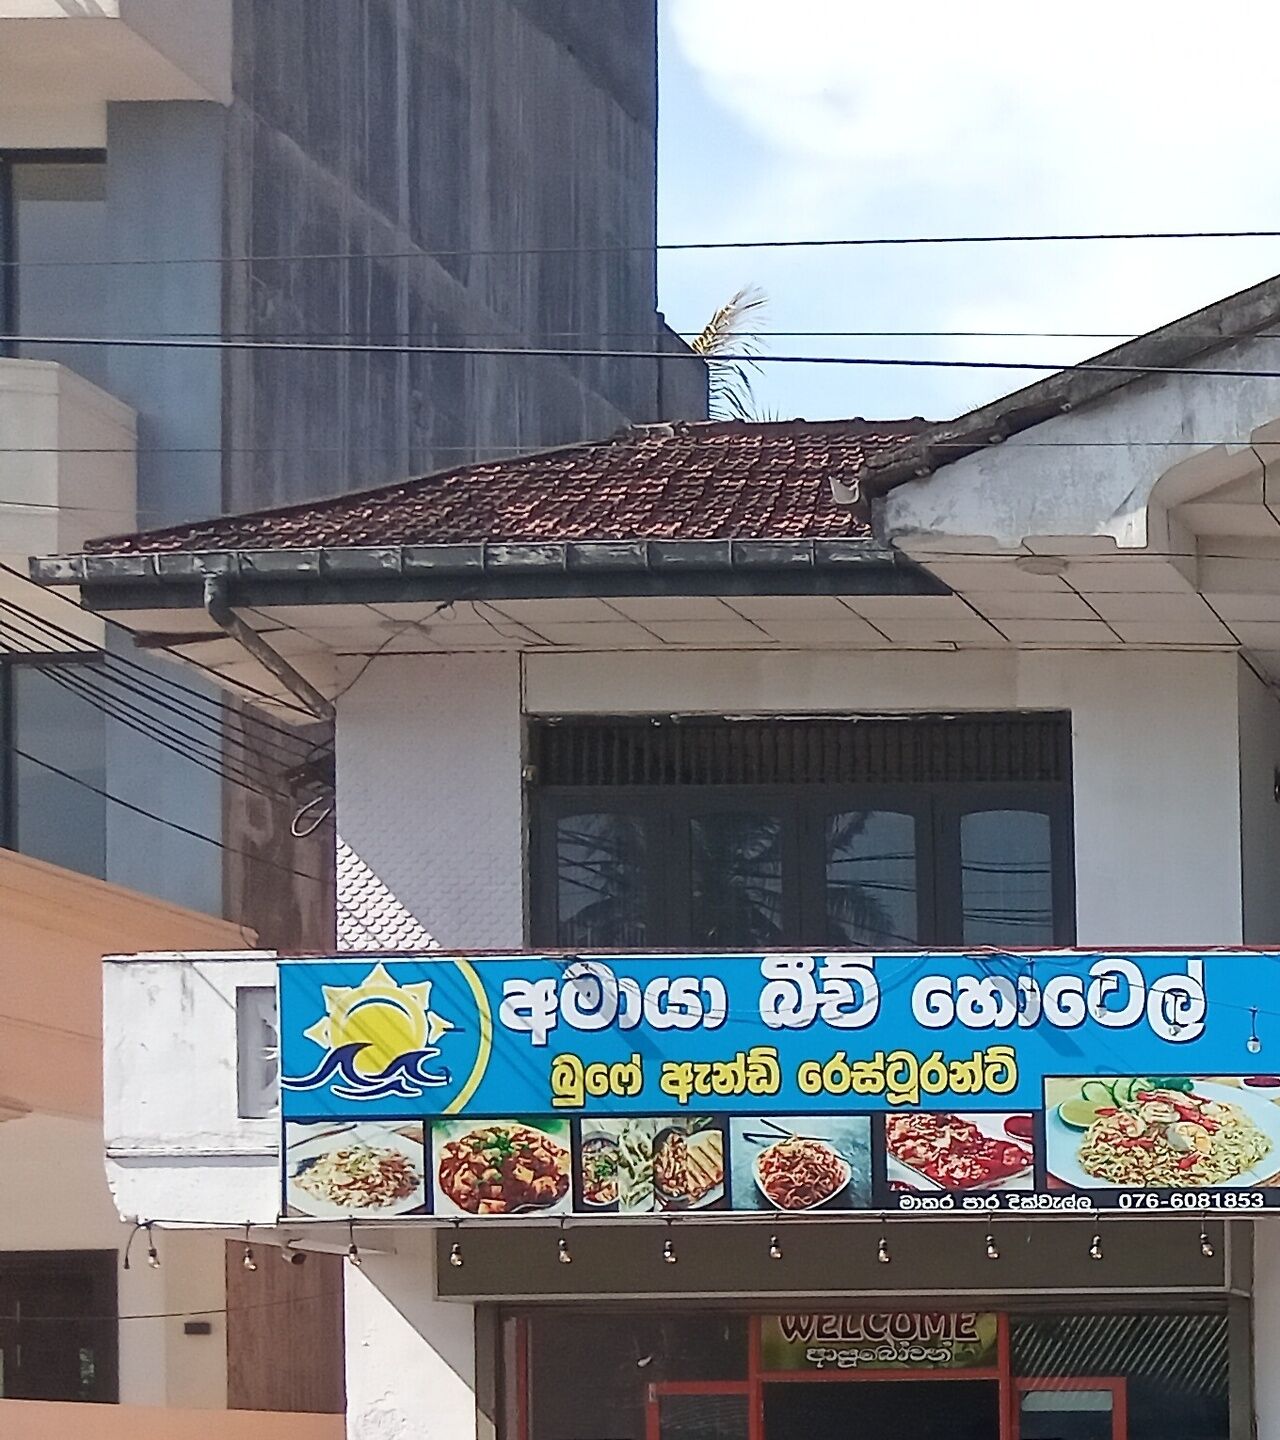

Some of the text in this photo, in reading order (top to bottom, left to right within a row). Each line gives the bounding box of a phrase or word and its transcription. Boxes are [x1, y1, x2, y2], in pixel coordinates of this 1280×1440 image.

[499, 961, 728, 1047] අමායා
[912, 958, 1208, 1043] හොටෙල්
[1118, 1193, 1265, 1209] 076-6081853
[778, 1312, 980, 1343] WELCOME
